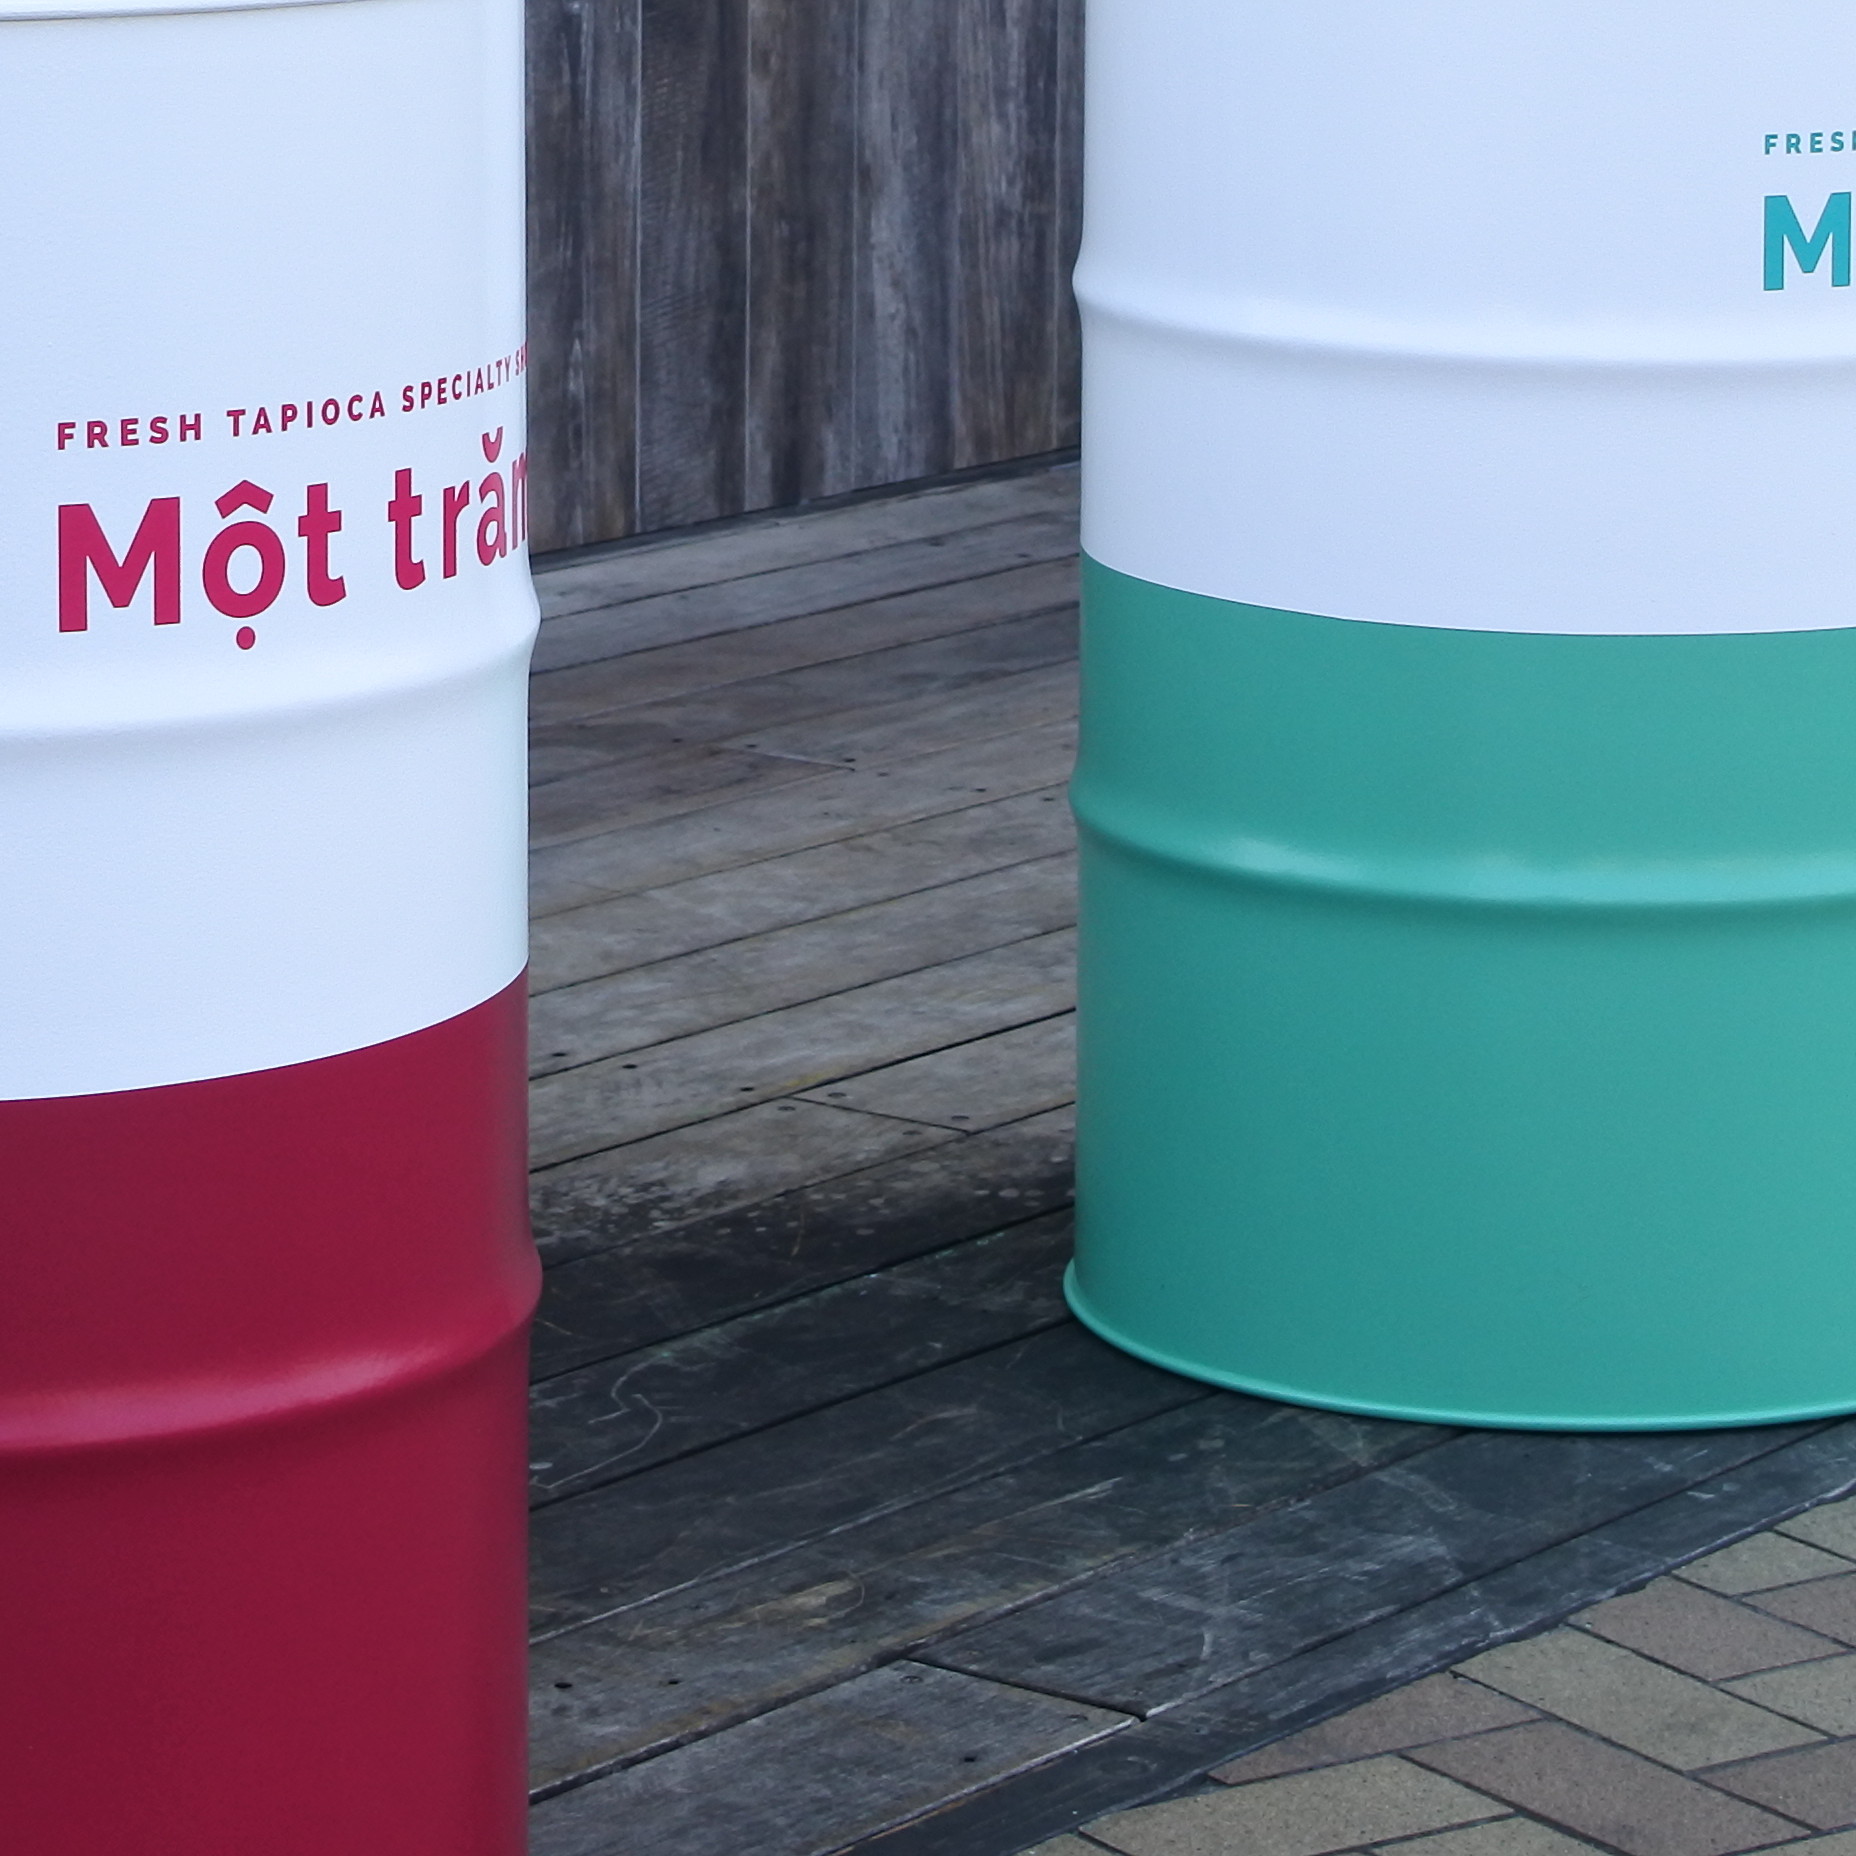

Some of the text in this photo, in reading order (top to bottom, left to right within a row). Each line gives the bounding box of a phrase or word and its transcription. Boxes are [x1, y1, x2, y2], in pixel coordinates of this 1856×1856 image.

[57, 413, 202, 450] FRESH
[226, 391, 385, 437] TAPIOCA
[402, 355, 512, 413] SPECIALTY
[58, 479, 347, 650] Một
